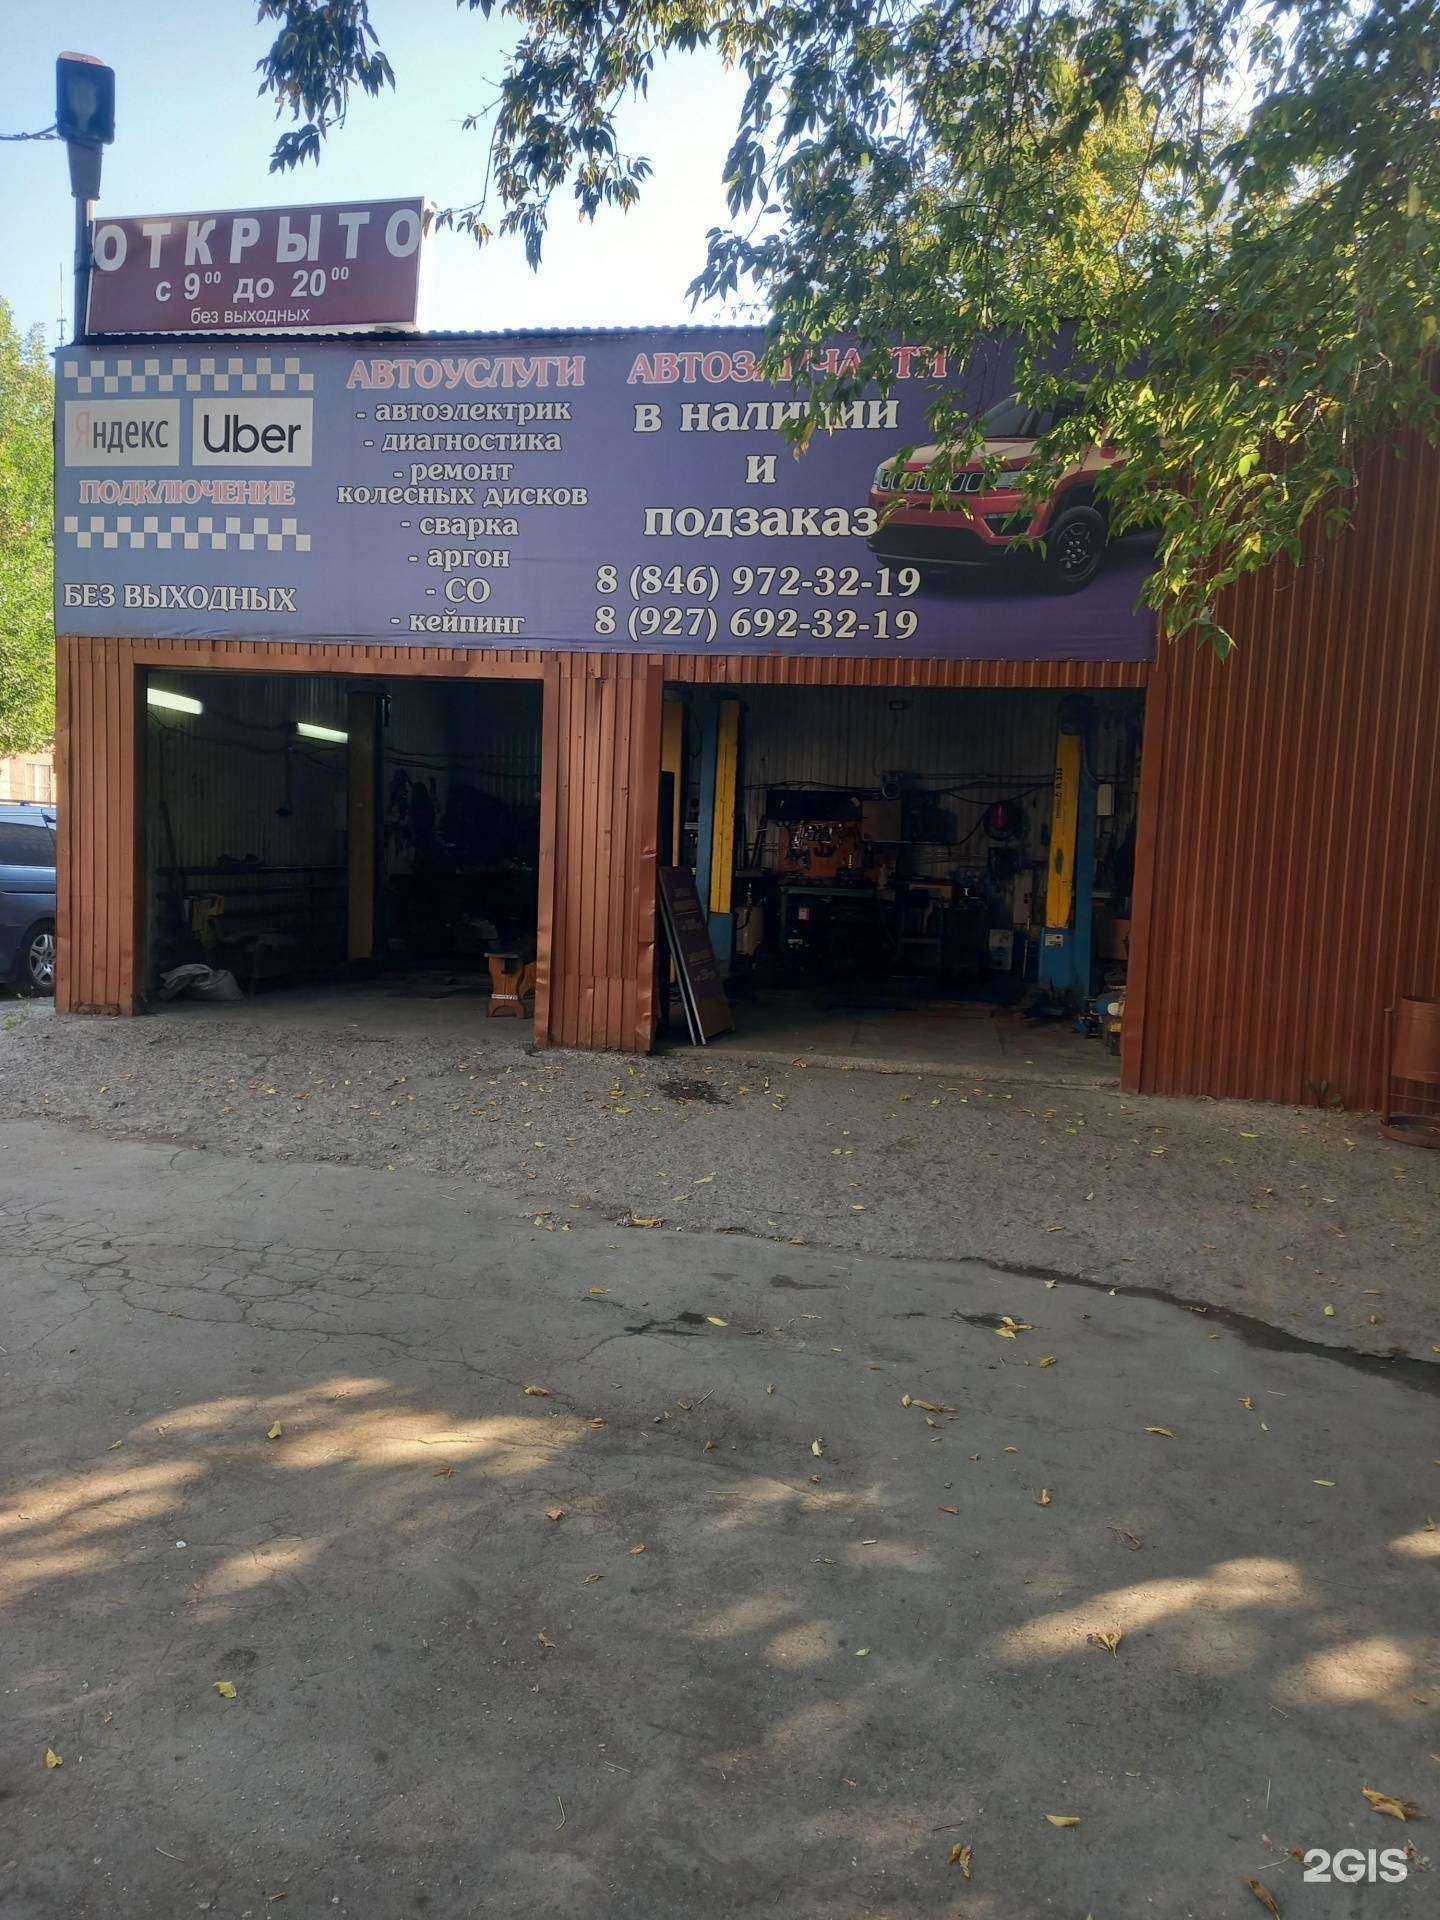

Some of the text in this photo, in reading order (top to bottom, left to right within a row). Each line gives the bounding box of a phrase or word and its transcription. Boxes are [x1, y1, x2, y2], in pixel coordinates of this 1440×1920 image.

[93, 208, 421, 272] ОТКРЫТО
[155, 281, 172, 301] с
[232, 277, 275, 303] до
[190, 306, 311, 325] без выходных
[346, 355, 586, 389] АВТОУСЛУГИ
[375, 402, 572, 426] автоэлектрик
[633, 403, 663, 433] в
[74, 411, 169, 454] Яндекс
[203, 414, 302, 454] Uber
[381, 432, 562, 453] диагностика
[410, 462, 514, 486] ремонт
[745, 454, 777, 484] и
[79, 479, 296, 507] ПОДКЛЮЧЕНИЕ
[337, 485, 588, 509] колесных дисков
[418, 516, 520, 541] сварка
[643, 506, 879, 539] подзаказ
[427, 549, 510, 573] аргон
[595, 564, 922, 602] 8 (846) 972-32-19
[63, 583, 298, 613] БЕЗ ВЫХОДНЫХ
[409, 607, 526, 635] кейпинг
[594, 605, 920, 643] 8 (927) 692-32-19
